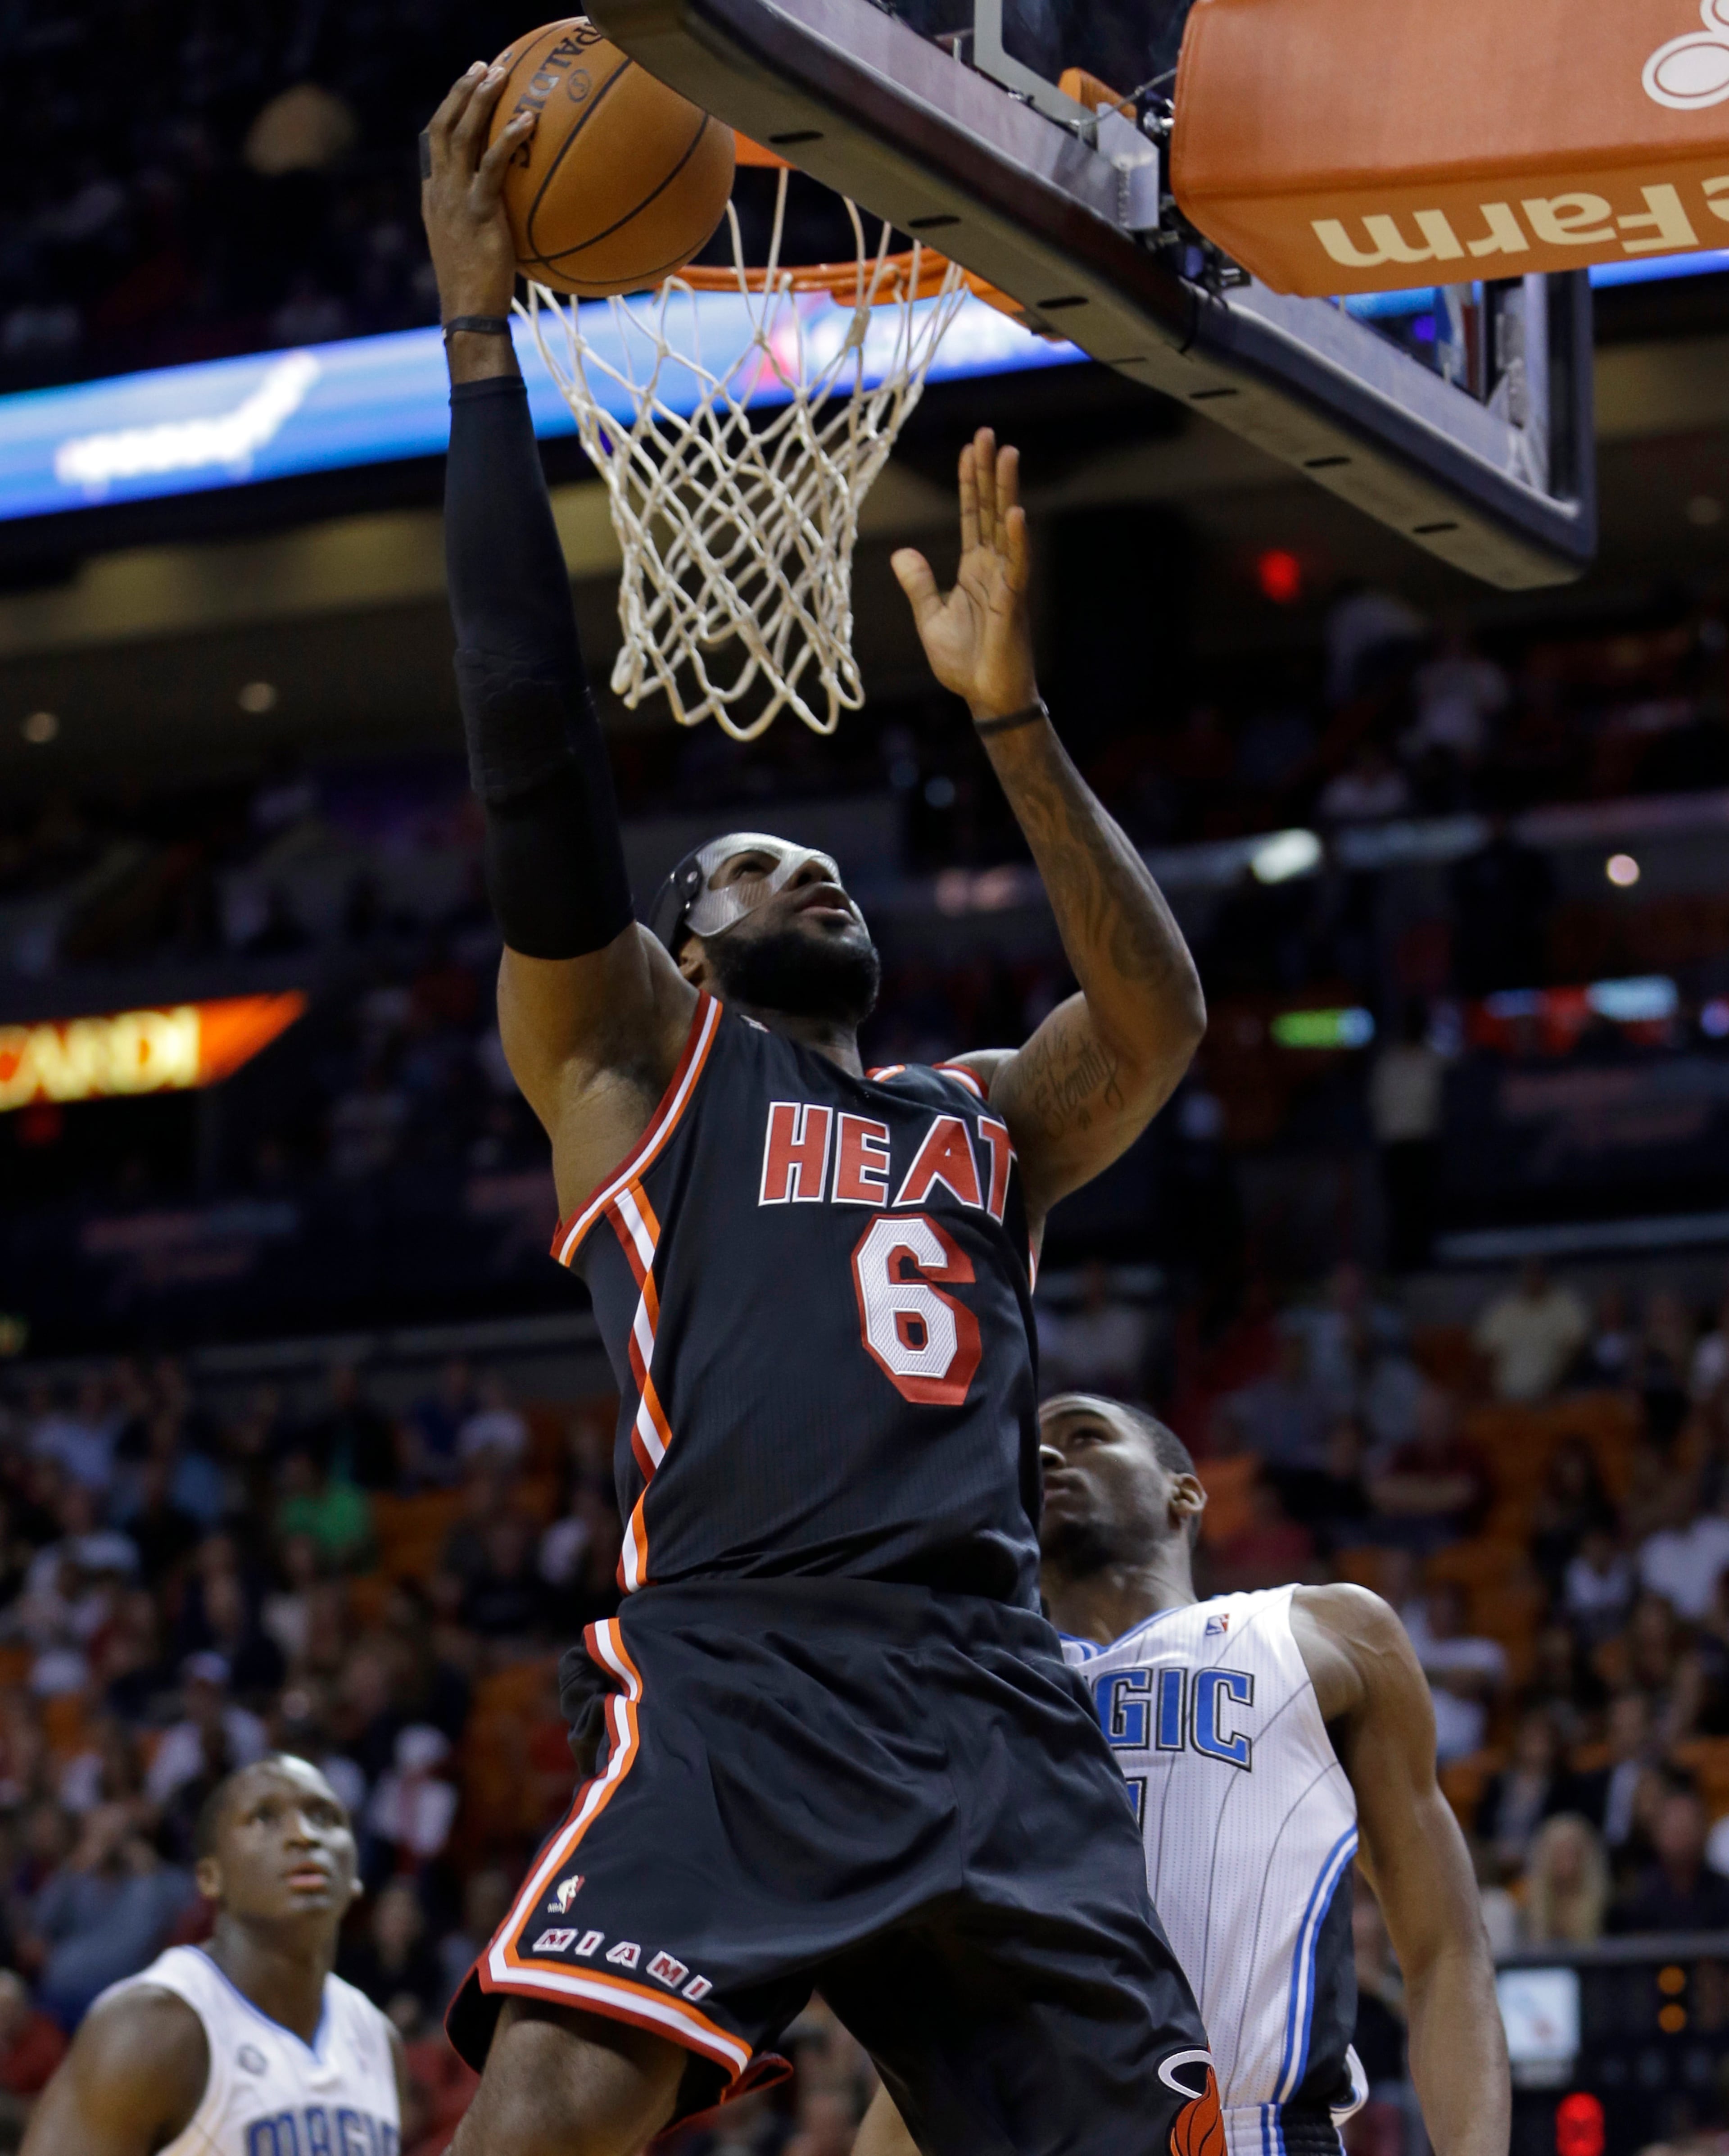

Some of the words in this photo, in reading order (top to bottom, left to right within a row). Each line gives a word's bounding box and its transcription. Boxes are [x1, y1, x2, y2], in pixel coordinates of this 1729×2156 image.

[1310, 183, 1700, 267] Farm
[758, 1101, 1018, 1226] HEAT
[851, 1212, 982, 1406] 6
[1092, 1667, 1255, 1773] GIC
[533, 1928, 712, 2001] MIAMI
